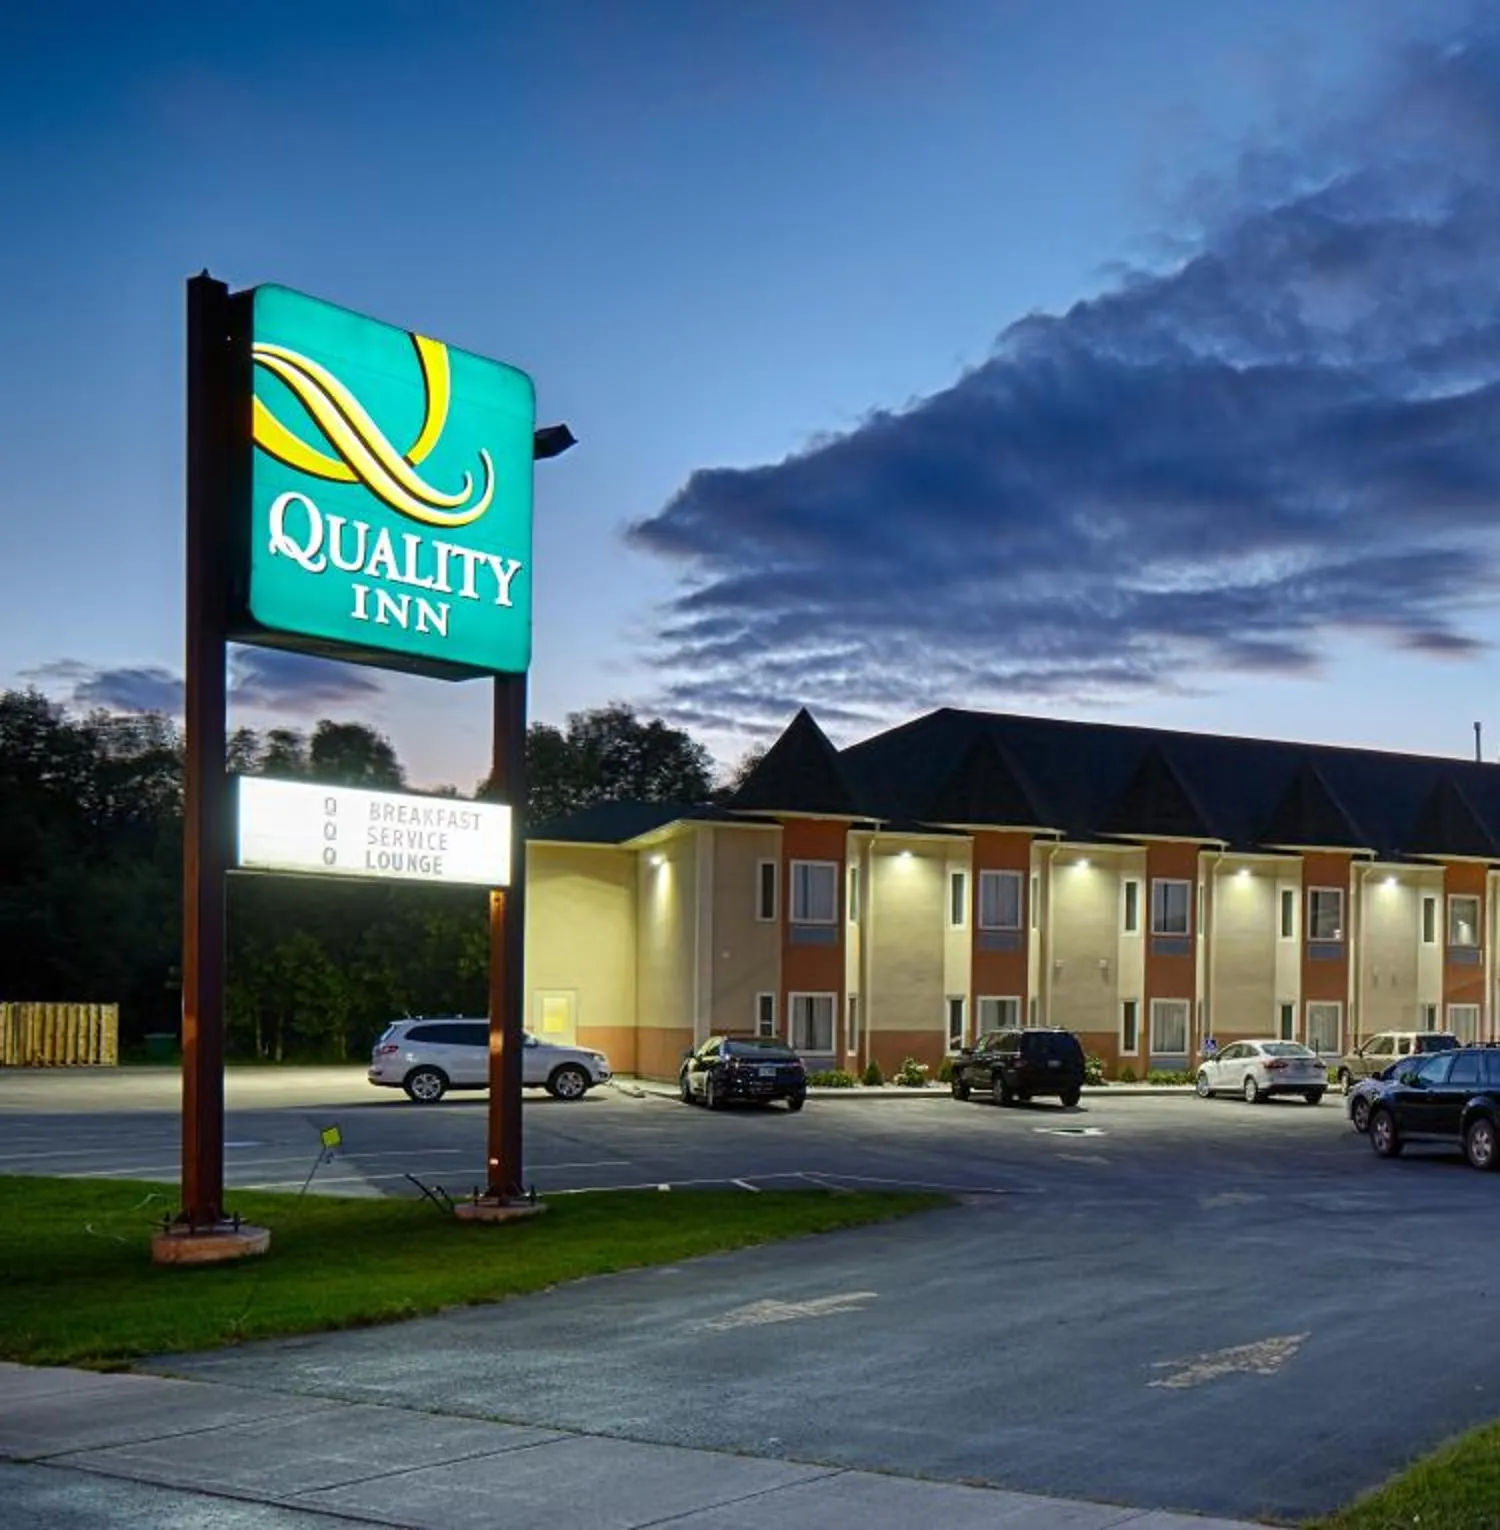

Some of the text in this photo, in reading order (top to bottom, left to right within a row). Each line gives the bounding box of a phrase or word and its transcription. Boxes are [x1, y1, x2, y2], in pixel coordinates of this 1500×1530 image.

[268, 491, 522, 607] QUALITY
[351, 583, 451, 637] INN
[370, 802, 481, 831] BREAKFAST
[367, 825, 448, 850] SERVICE
[365, 850, 443, 875] LOUNGE
